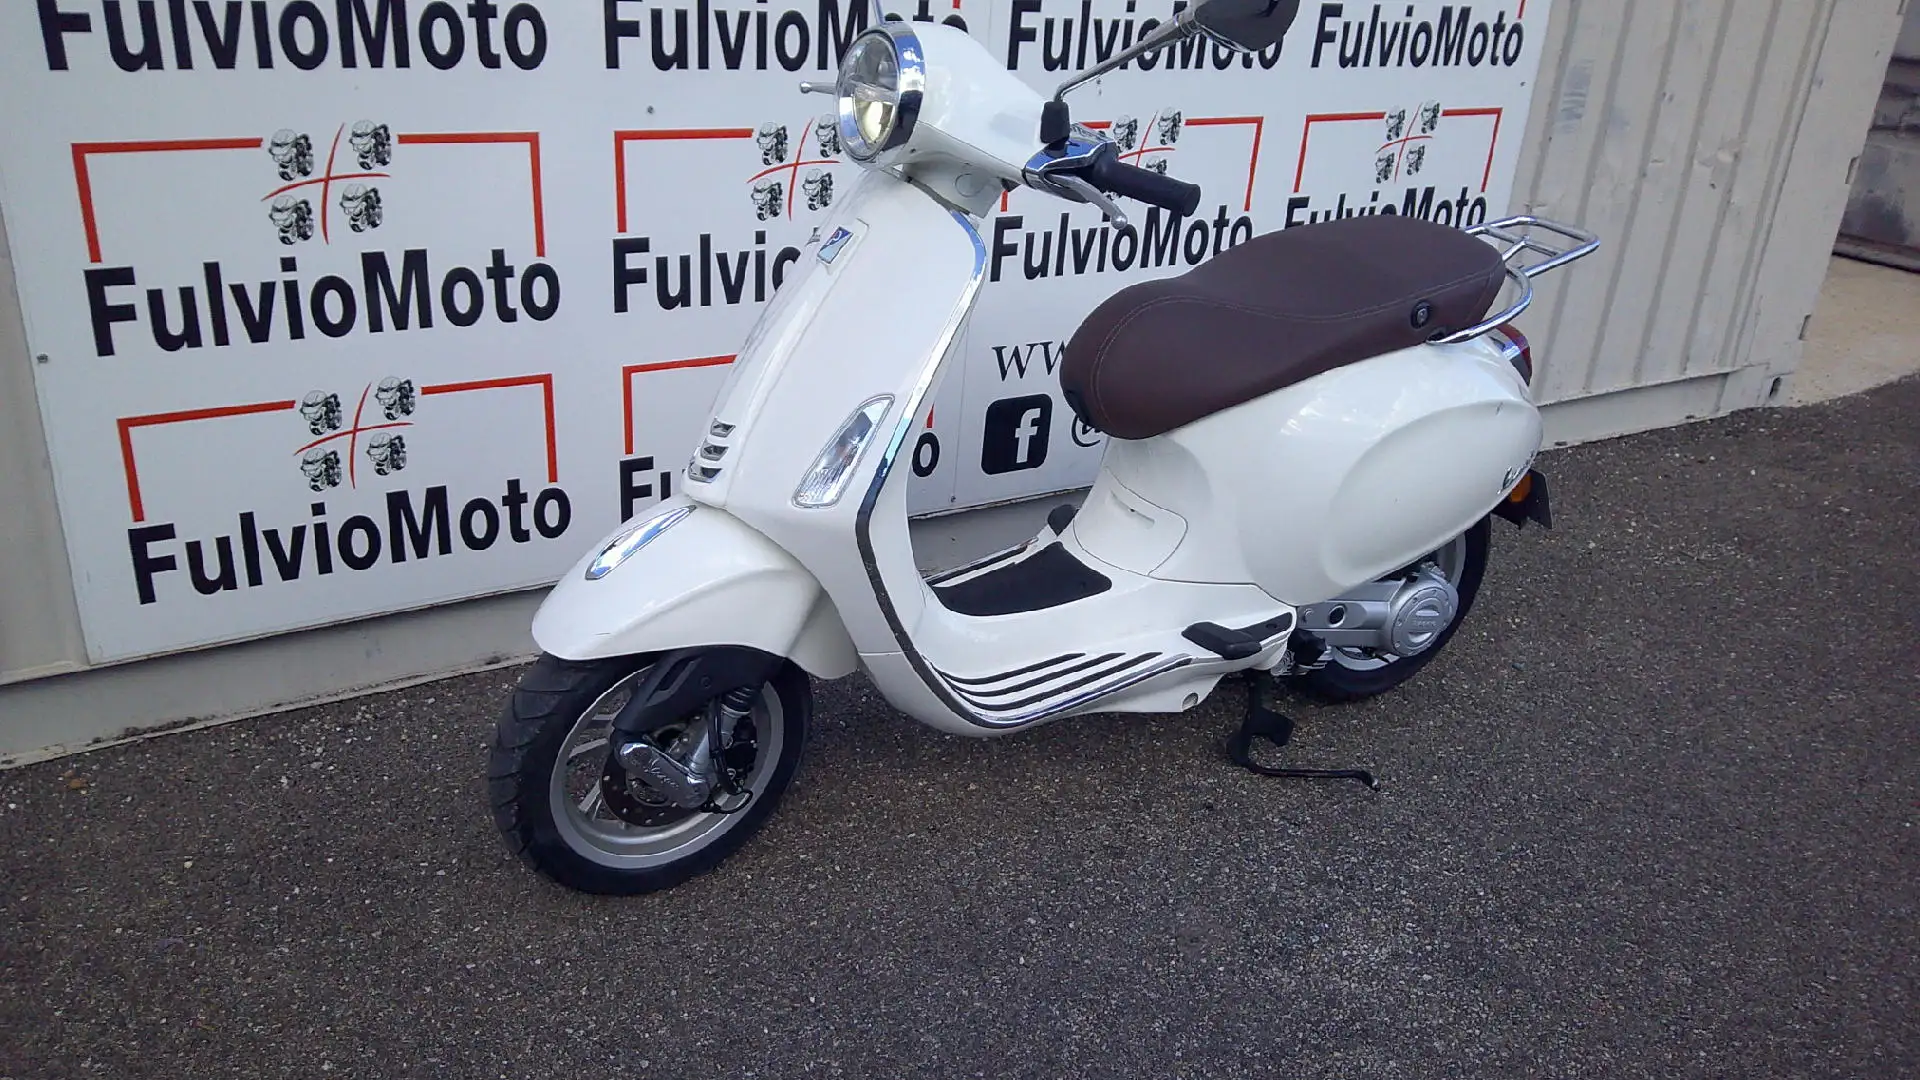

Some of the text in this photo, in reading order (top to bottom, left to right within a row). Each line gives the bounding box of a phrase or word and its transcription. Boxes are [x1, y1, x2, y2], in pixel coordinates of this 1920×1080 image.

[604, 0, 969, 72] FulvioM
[1310, 3, 1525, 69] FulvioMoto
[84, 248, 560, 357] FulvioMoto
[613, 230, 801, 313] Fulvio
[128, 478, 571, 605] FulvioMoto
